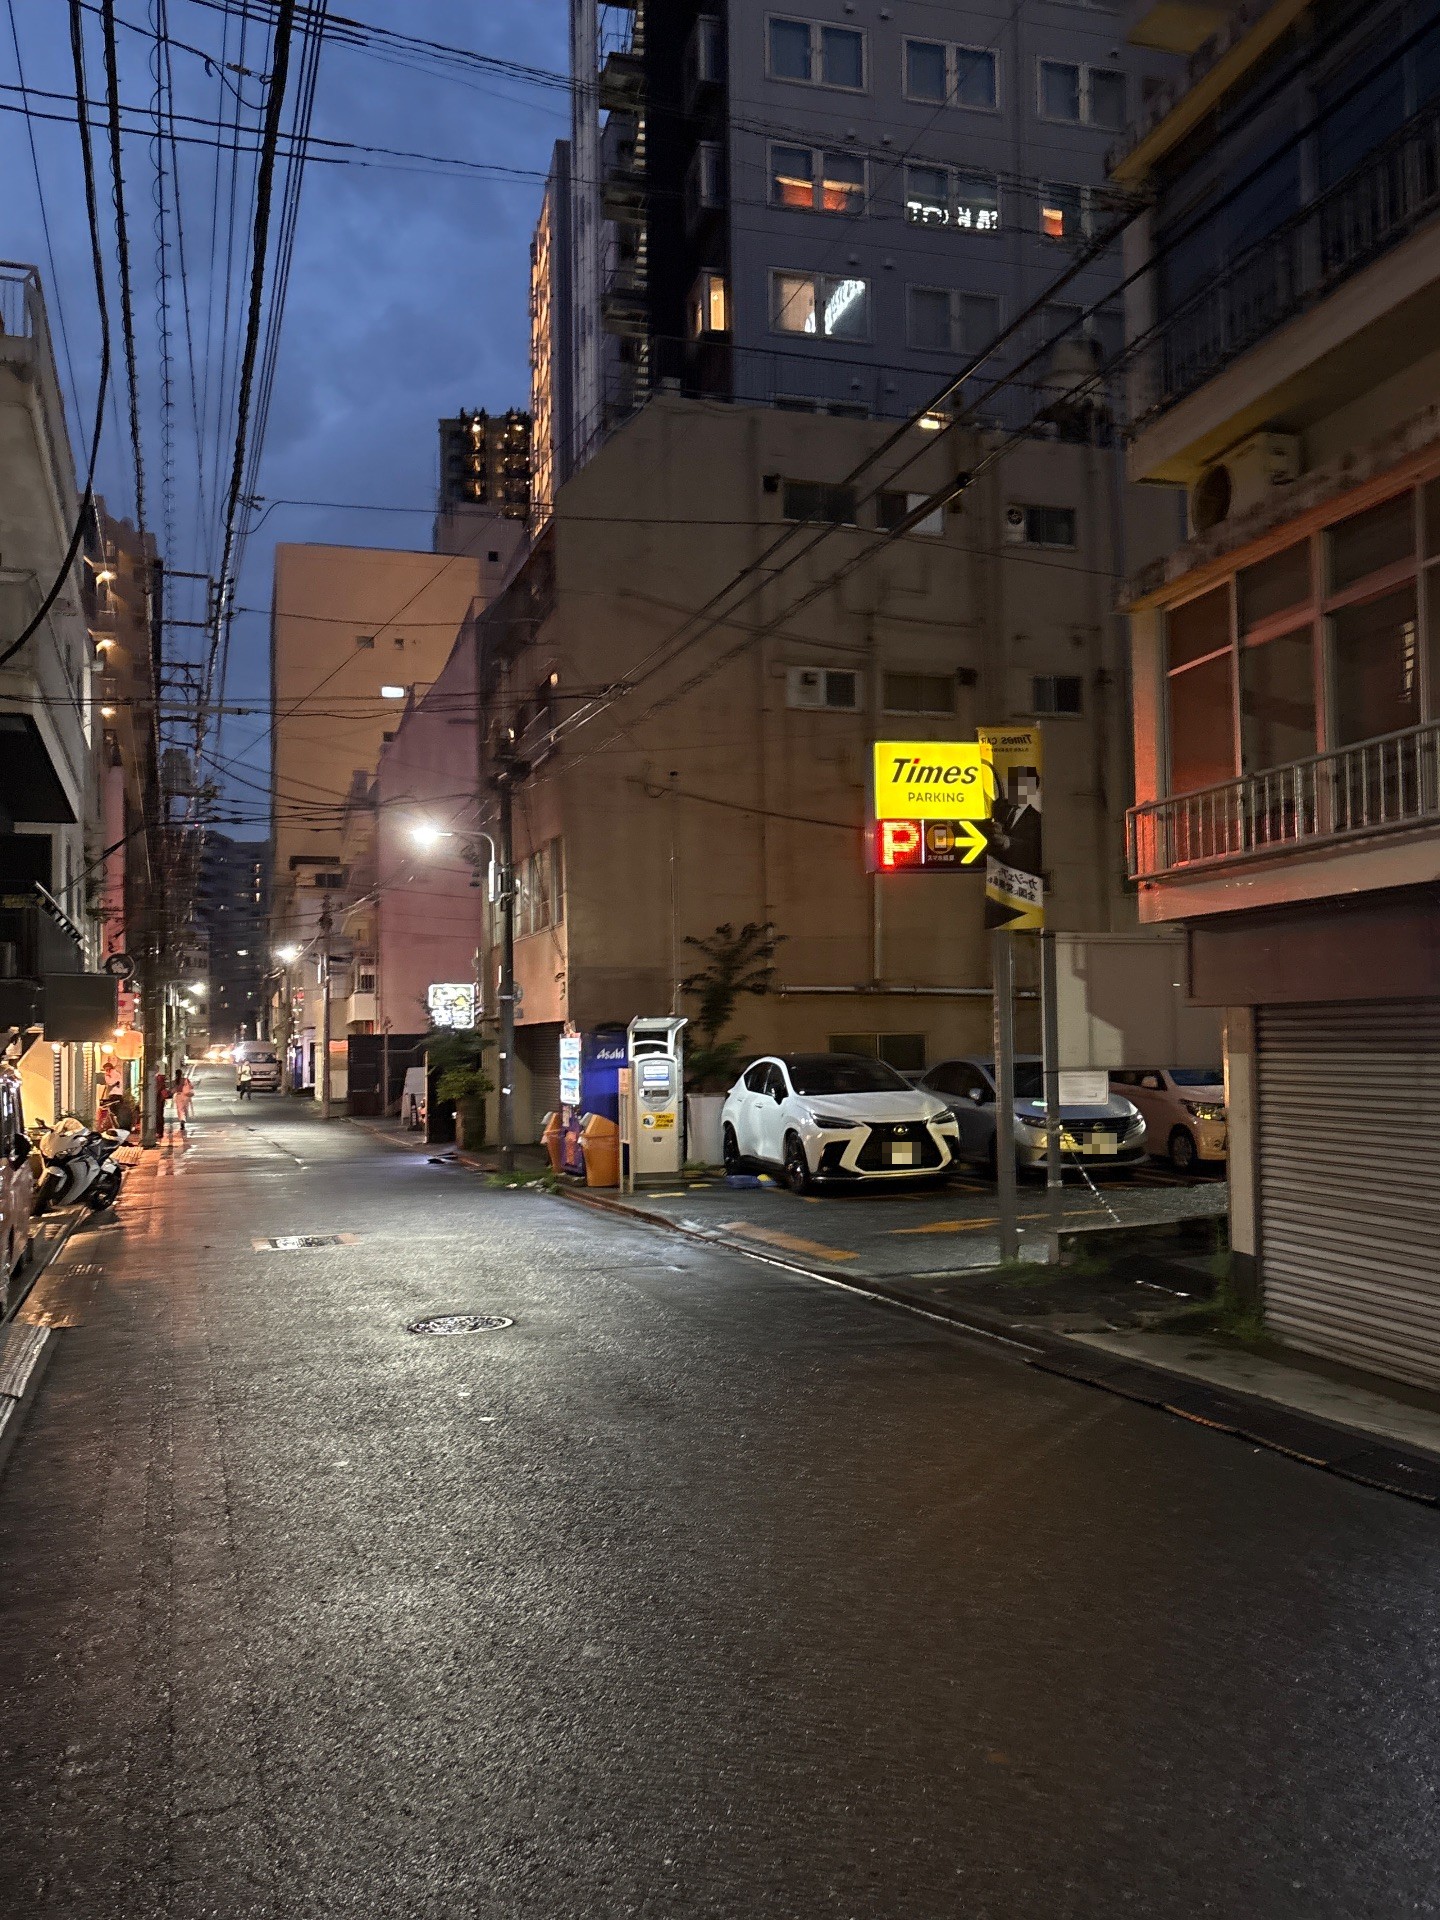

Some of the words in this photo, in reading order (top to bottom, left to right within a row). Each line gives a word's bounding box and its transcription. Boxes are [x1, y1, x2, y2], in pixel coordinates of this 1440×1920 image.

[892, 758, 979, 784] Times
[908, 792, 965, 803] PARKING
[882, 821, 920, 865] P
[596, 1048, 625, 1060] Asahi
